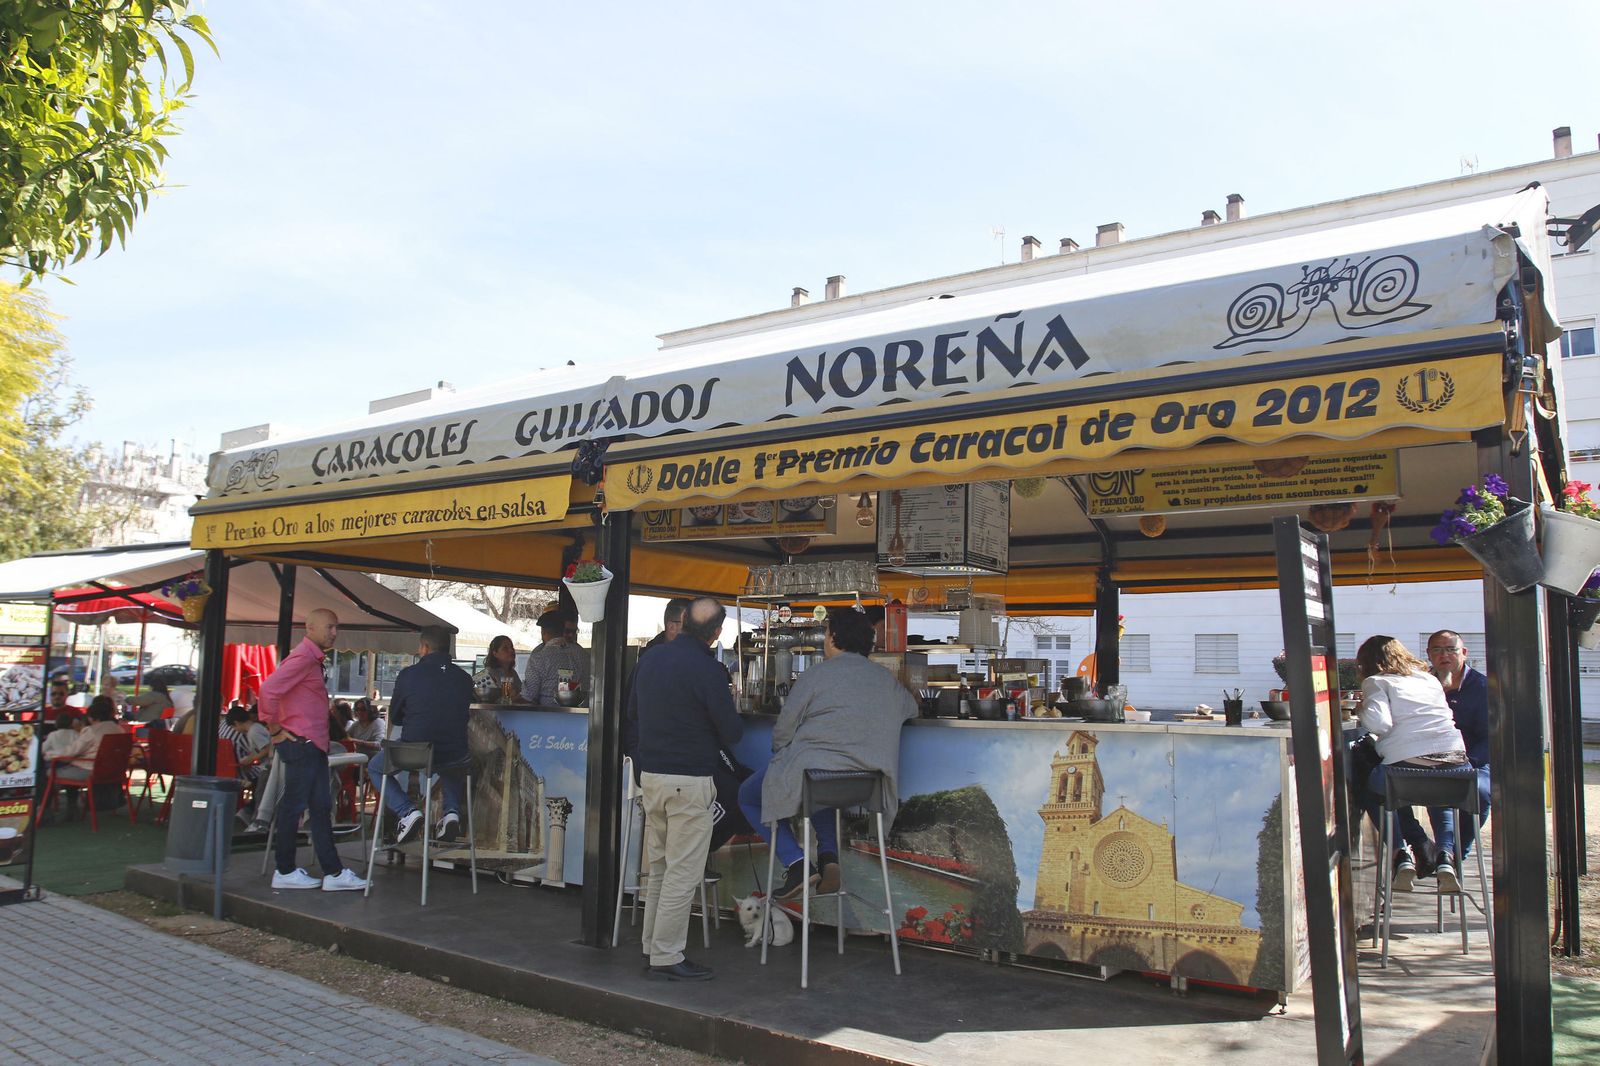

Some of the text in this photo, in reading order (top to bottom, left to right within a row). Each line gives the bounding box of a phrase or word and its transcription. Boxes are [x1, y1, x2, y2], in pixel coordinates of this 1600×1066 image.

[312, 311, 1090, 477] CARACOLES GUISADOS NOREÑA
[657, 456, 741, 491] Doble
[776, 436, 900, 477] Premio
[910, 415, 1068, 463] Caracol
[1080, 408, 1137, 445] de
[1150, 399, 1236, 434] Oro
[1252, 377, 1380, 427] 2012
[1151, 470, 1188, 478] necesarios
[1190, 468, 1207, 476] para
[1209, 465, 1220, 473] las
[1155, 480, 1171, 488] para
[1300, 477, 1307, 485] el
[1099, 497, 1128, 507] PREMIO
[1129, 496, 1145, 504] ORO
[1184, 497, 1201, 506] Sus
[1204, 493, 1262, 506] propiedades
[1265, 491, 1283, 500] son
[225, 521, 266, 541] Preio
[272, 516, 299, 536] Oro
[305, 521, 313, 534] a
[317, 512, 335, 535] los
[341, 510, 397, 536] mejores
[402, 499, 471, 525] caracoles
[477, 503, 497, 521] en
[501, 492, 547, 519] salsa
[529, 735, 543, 749] El
[545, 735, 575, 751] Sabor
